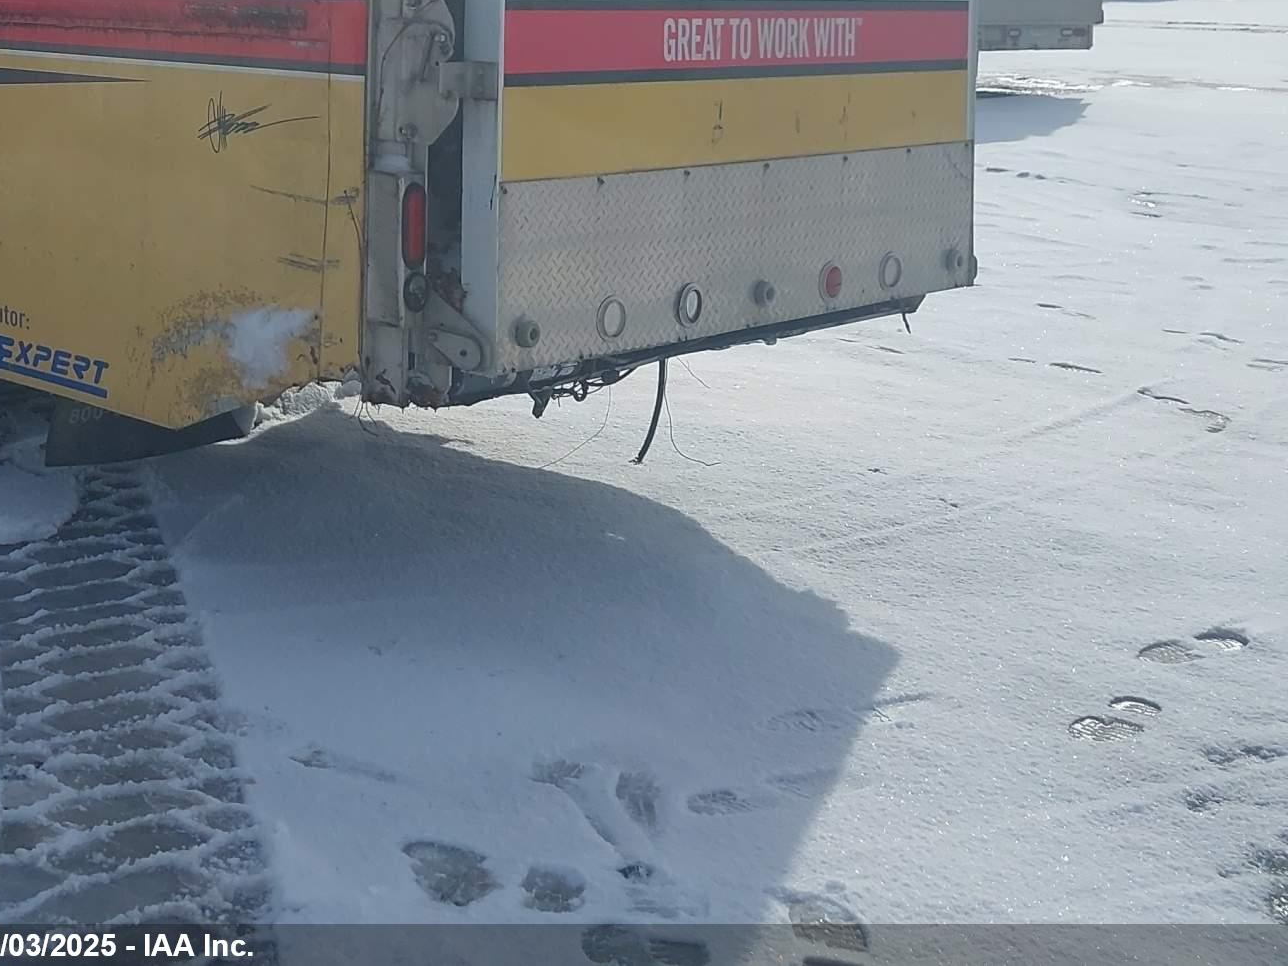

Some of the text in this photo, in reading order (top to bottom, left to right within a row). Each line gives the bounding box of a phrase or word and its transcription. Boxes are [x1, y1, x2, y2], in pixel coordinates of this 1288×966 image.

[663, 17, 725, 62] GREAT
[729, 17, 753, 60] TO
[757, 17, 810, 59] WORK
